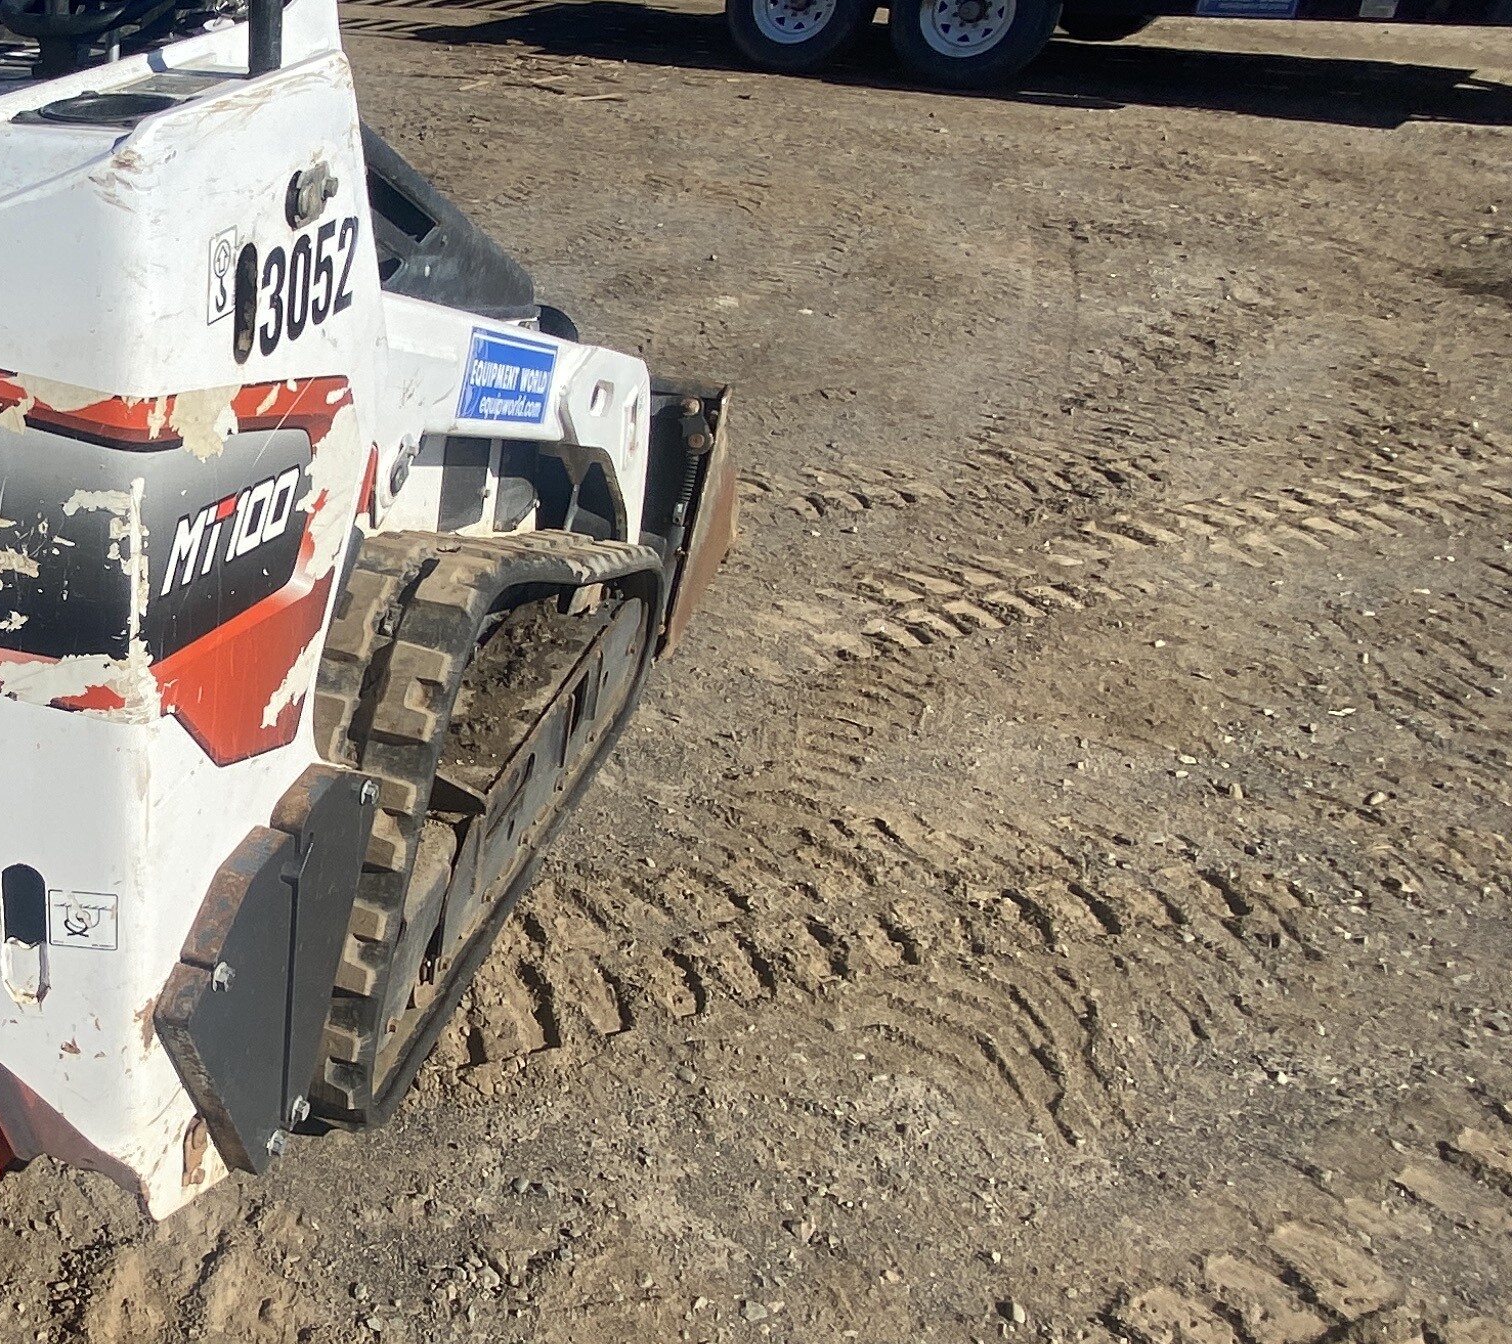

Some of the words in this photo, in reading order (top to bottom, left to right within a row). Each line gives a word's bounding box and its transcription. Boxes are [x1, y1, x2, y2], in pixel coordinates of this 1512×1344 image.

[469, 360, 521, 390] EQUIPMENT
[519, 367, 552, 395] WORLD
[479, 392, 542, 420] equipworld.com
[159, 464, 300, 598] MT100
